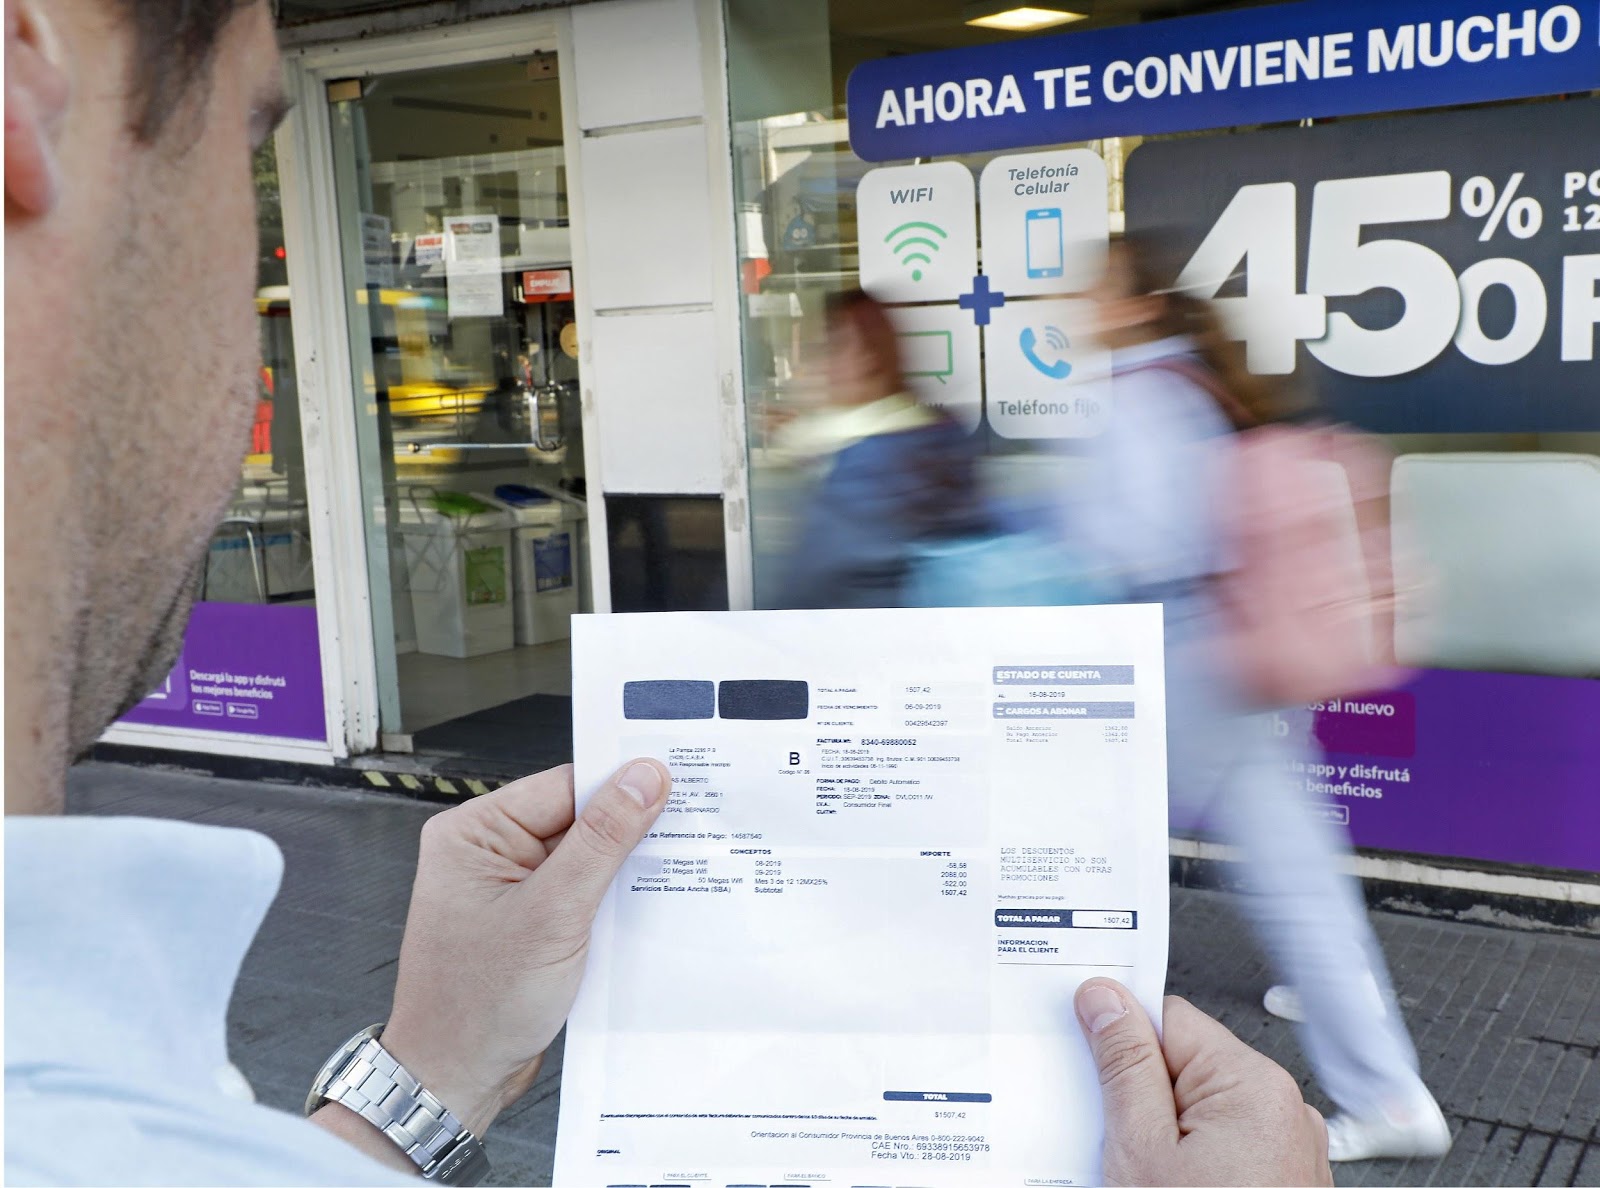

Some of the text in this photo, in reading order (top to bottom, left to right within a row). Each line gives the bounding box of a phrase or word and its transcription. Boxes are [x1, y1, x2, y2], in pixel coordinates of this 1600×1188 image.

[874, 4, 1582, 129] AHORA TE CONVIENE MUCHO
[1007, 163, 1079, 181] Telefonía
[1014, 181, 1070, 196] Celular
[889, 187, 934, 205] WIFI
[997, 399, 1069, 416] Teléfono
[996, 670, 1101, 679] ESTADO DE CUENTA
[1005, 707, 1087, 716] CARGOS A ABONAR
[1303, 698, 1395, 717] os al nuevo
[789, 751, 801, 766] B
[1307, 763, 1336, 778] app
[1337, 764, 1348, 779] y
[1349, 762, 1411, 783] disfrutá
[1306, 778, 1383, 800] beneficios
[1000, 847, 1075, 855] LOS DESCUENTOS
[672, 859, 695, 867] Megas
[1000, 856, 1108, 865] MULTISERVICIO NO SON
[671, 867, 695, 876] Megas
[1000, 865, 1113, 874] ACUMULABLES CON OTRAS
[707, 877, 730, 885] Megas
[1000, 874, 1060, 882] PROMOCIONES
[630, 885, 662, 893] Servicios
[663, 885, 685, 893] Banda
[686, 885, 710, 893] Ancha
[754, 886, 784, 894] Subtotal
[997, 914, 1023, 923] TOTAL
[1022, 915, 1031, 923] A
[1031, 915, 1061, 923] PAGAR
[922, 1093, 948, 1101] TOTAL
[798, 1131, 840, 1140] Consumidor
[841, 1132, 873, 1141] Provincia
[873, 1132, 883, 1141] de
[884, 1133, 911, 1142] Buenos
[911, 1133, 930, 1142] Aires
[871, 1141, 892, 1151] CAE
[871, 1151, 898, 1161] Fecha
[921, 1152, 971, 1162] 28-08-2019
